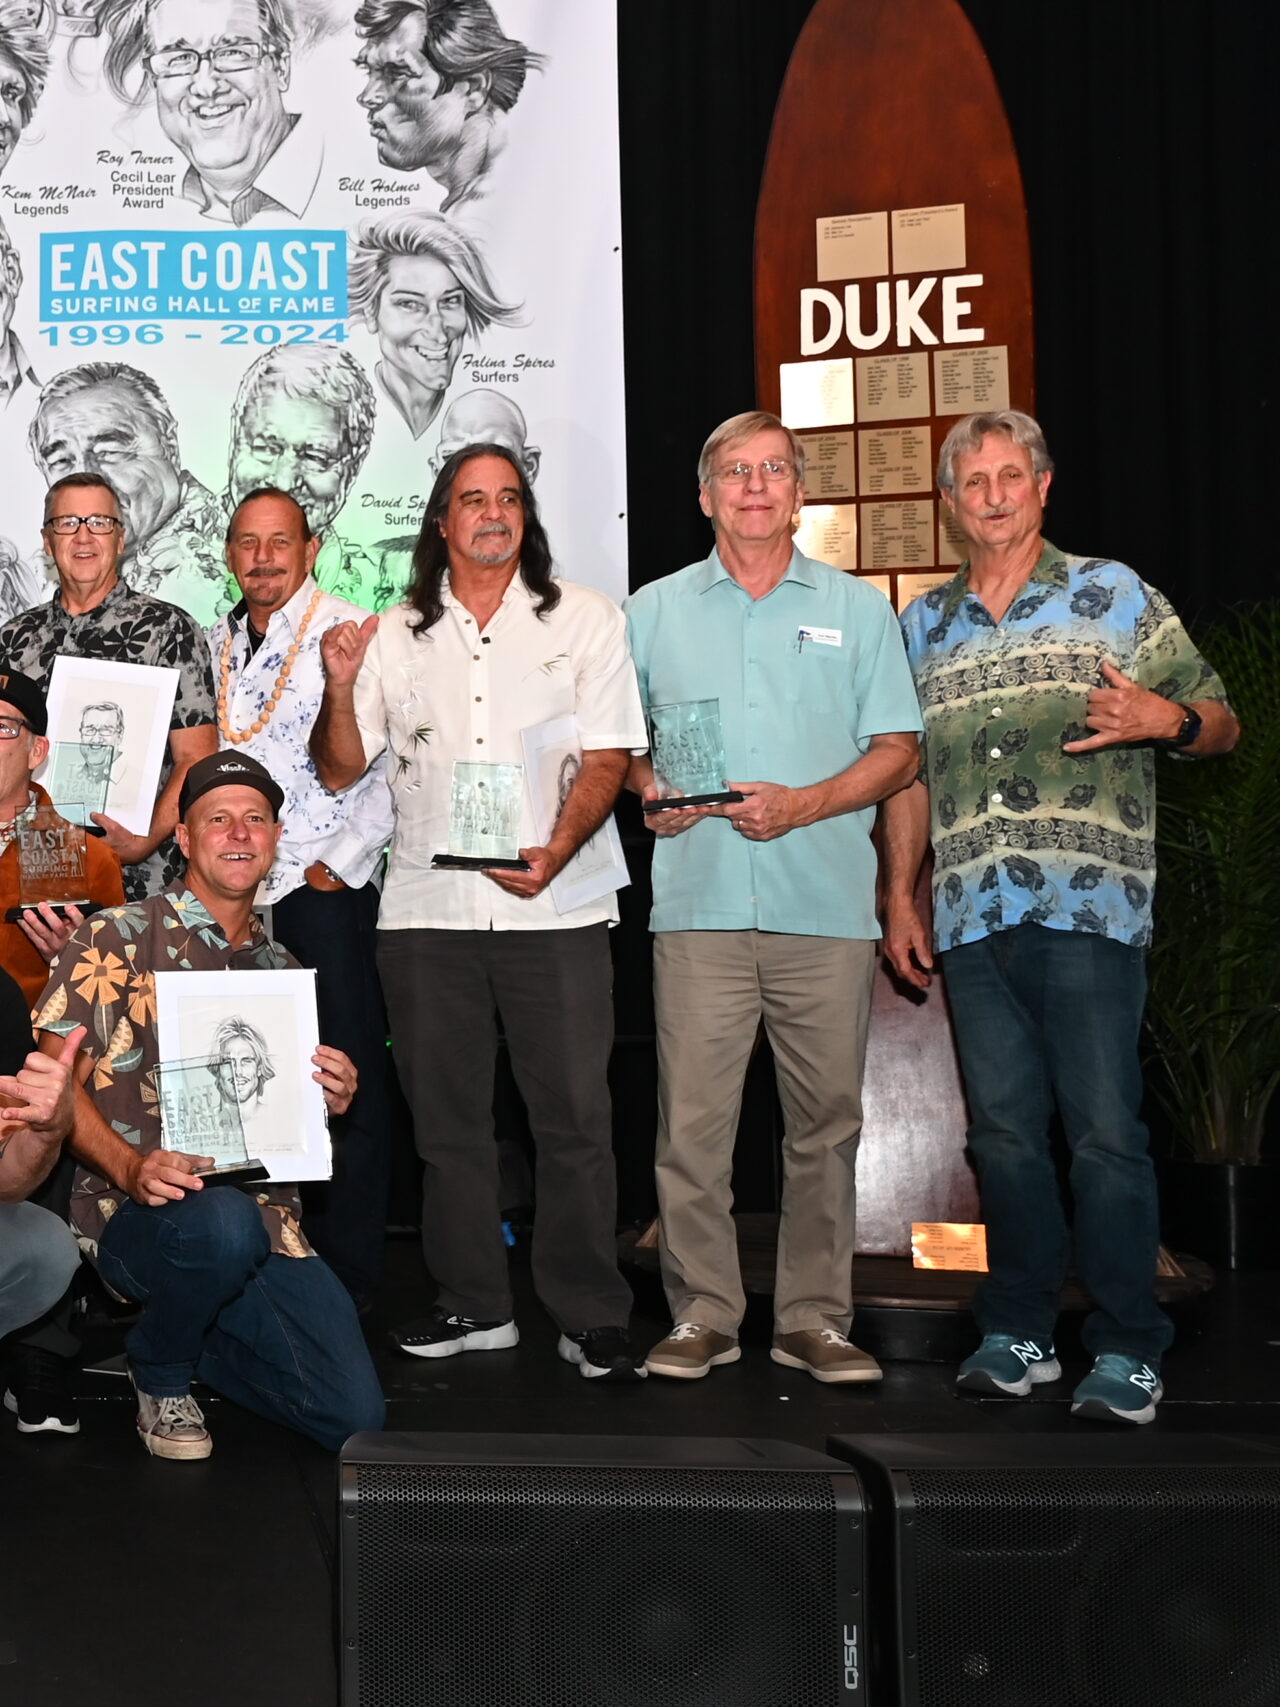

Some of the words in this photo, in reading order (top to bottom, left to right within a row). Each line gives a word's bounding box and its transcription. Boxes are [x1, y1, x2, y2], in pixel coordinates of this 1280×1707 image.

[96, 150, 124, 167] Roy
[130, 150, 174, 165] Turner
[110, 171, 144, 183] Cecil
[147, 172, 176, 183] Lear
[338, 177, 365, 191] Bill
[370, 178, 420, 192] Holmes
[2, 185, 33, 200] Kem
[39, 185, 97, 200] McNair
[112, 184, 174, 198] President
[14, 203, 69, 218] Legends
[122, 197, 164, 209] Award
[355, 195, 410, 209] Legends
[51, 241, 166, 292] EAST
[181, 241, 335, 291] COAST
[50, 296, 158, 314] SURFING
[168, 296, 230, 313] HALL
[238, 298, 262, 313] OF
[269, 297, 335, 313] FAME
[800, 274, 985, 356] DUKE
[39, 324, 164, 346] 1996
[220, 323, 350, 345] 2024
[462, 353, 507, 369] Falina
[513, 354, 555, 371] Spires
[472, 371, 519, 383] Surfers
[361, 493, 402, 508] David
[407, 493, 426, 512] Sp
[384, 513, 423, 525] Surfer
[20, 828, 66, 850] EAST
[21, 848, 67, 866] COAST
[844, 1624, 859, 1690] QSC
